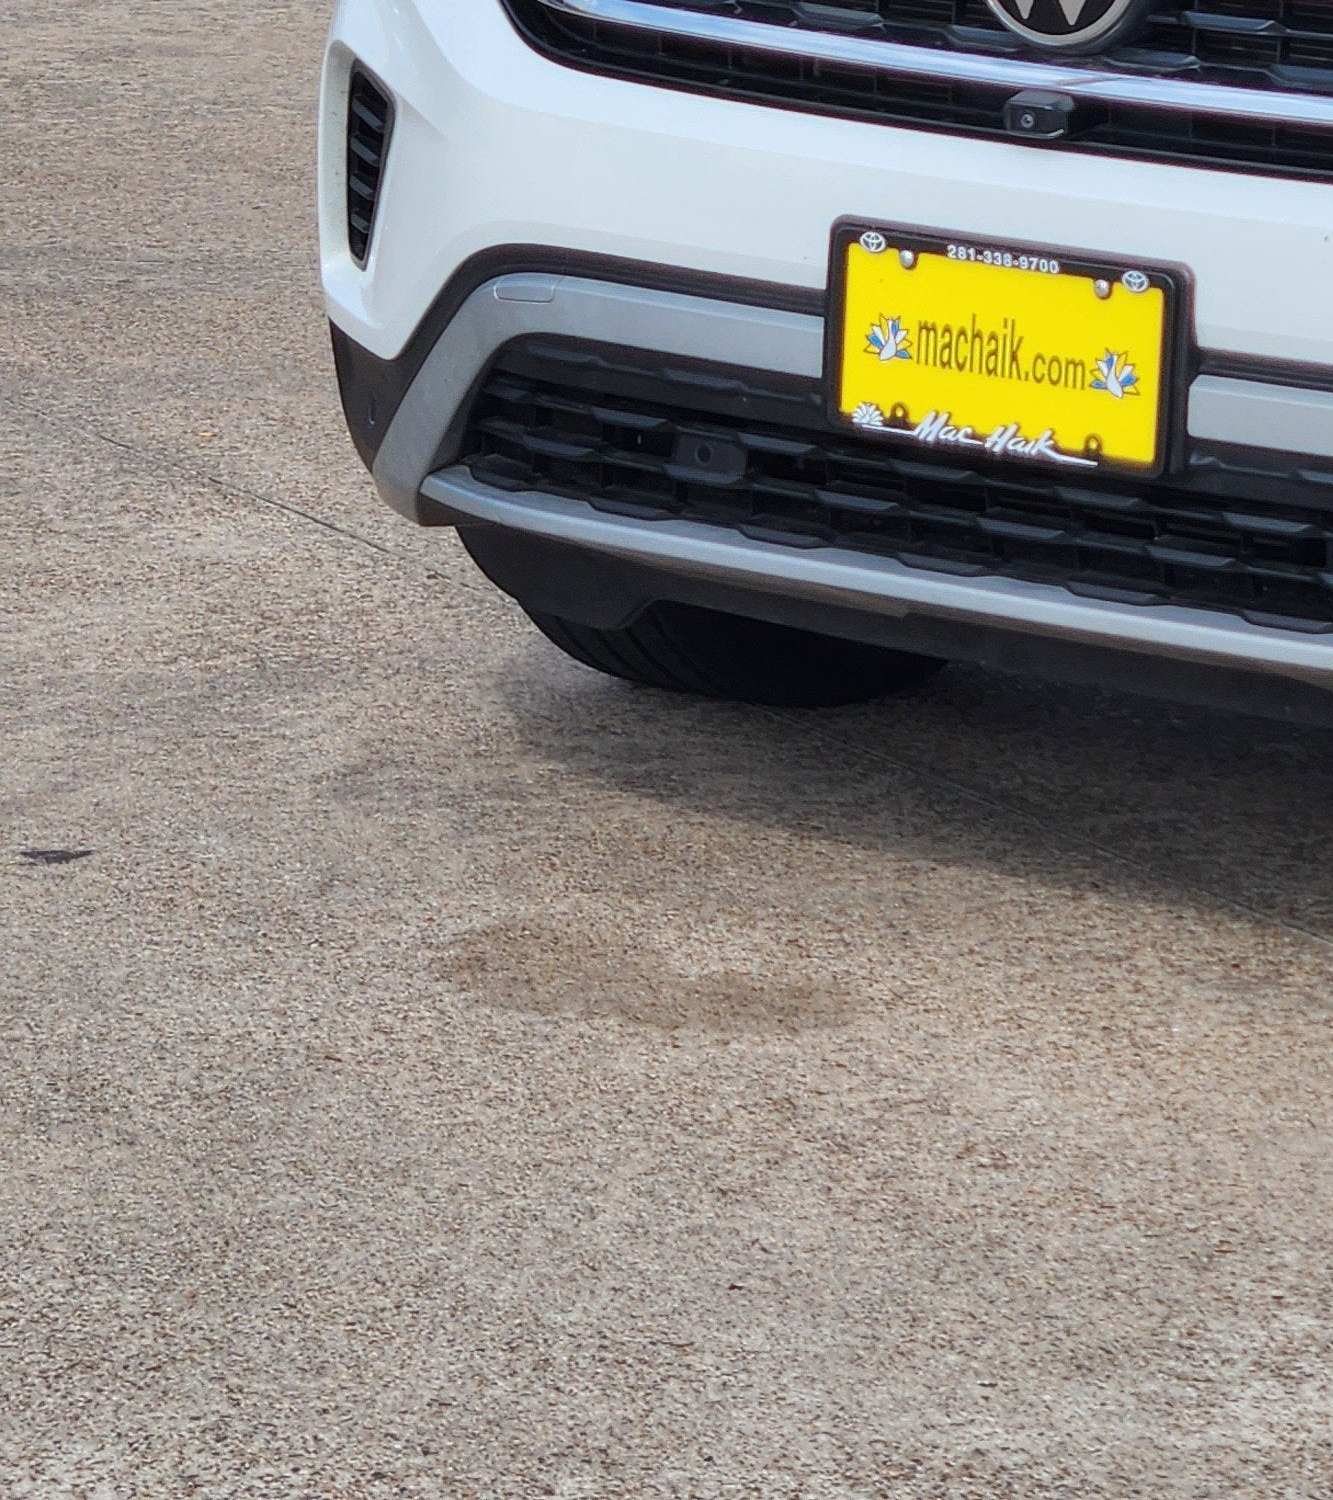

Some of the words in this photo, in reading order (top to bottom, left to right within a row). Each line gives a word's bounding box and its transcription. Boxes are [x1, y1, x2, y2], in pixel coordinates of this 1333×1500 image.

[916, 312, 1086, 390] machaik.com
[912, 409, 983, 443] Mac
[984, 422, 1066, 456] Haik
